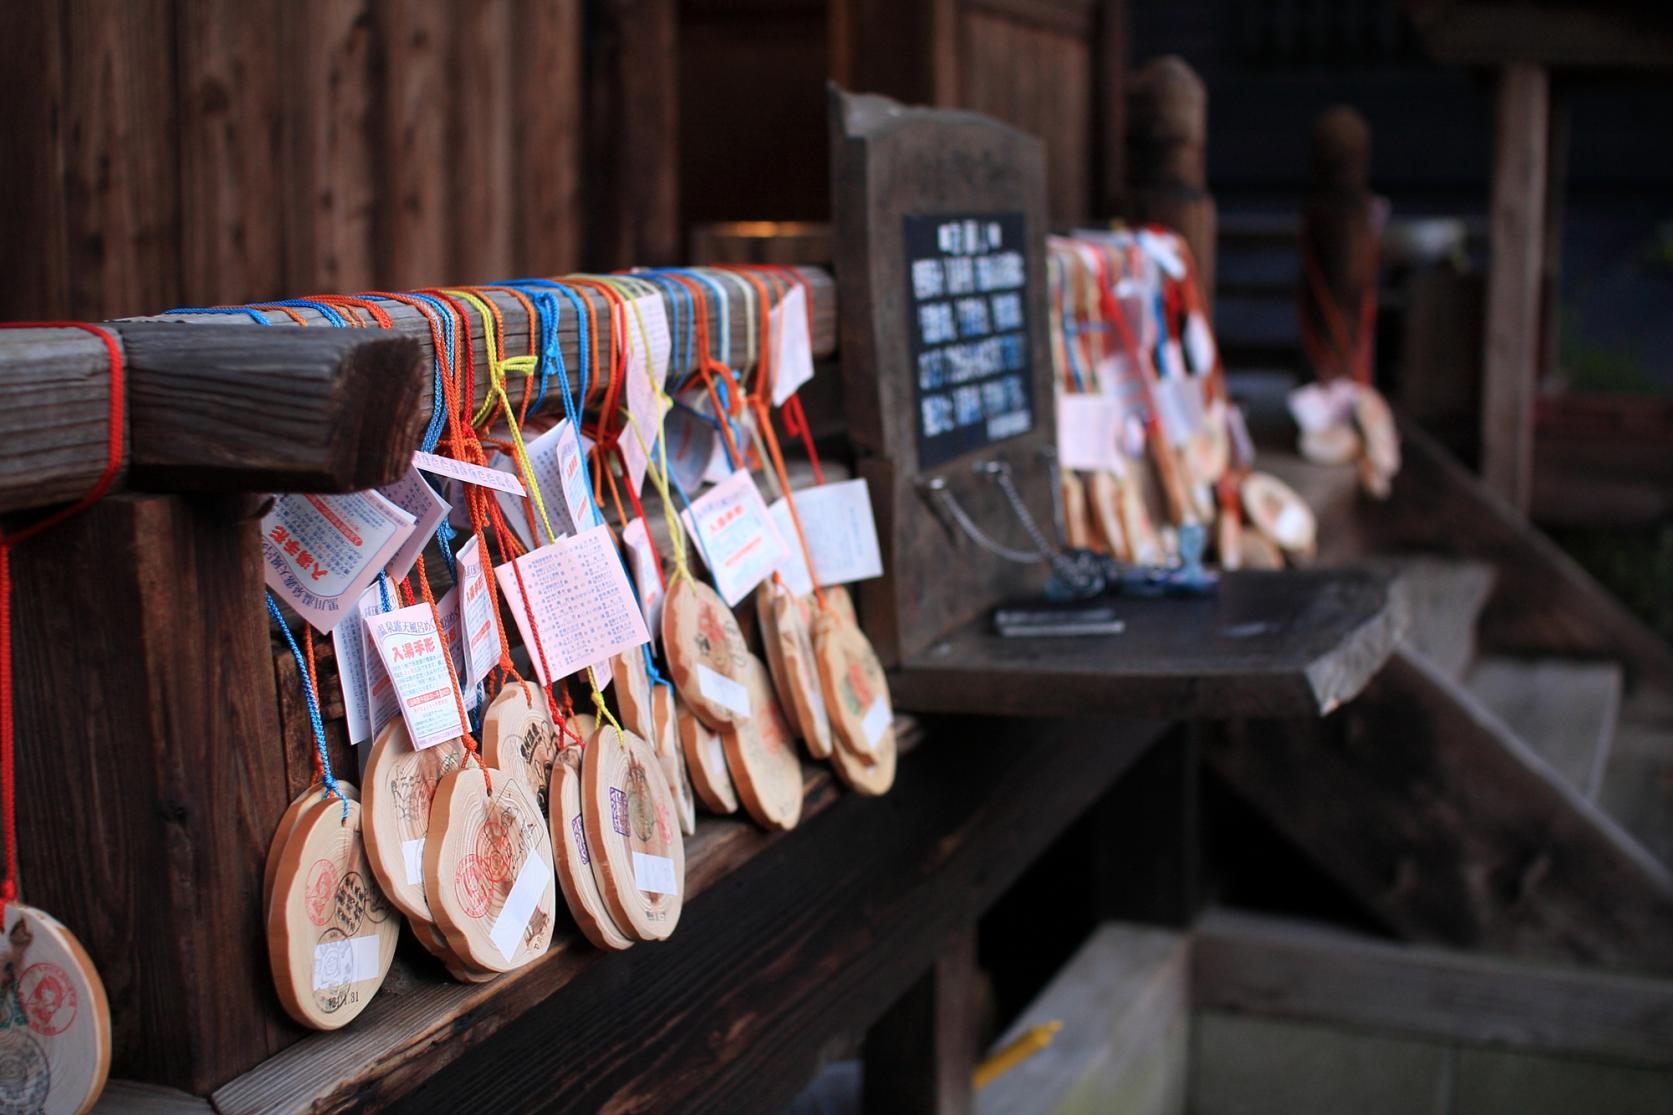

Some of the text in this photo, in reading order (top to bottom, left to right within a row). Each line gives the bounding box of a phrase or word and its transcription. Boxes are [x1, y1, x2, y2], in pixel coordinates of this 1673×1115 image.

[269, 525, 329, 581] 入湯手形
[391, 636, 436, 663] 入湯手形
